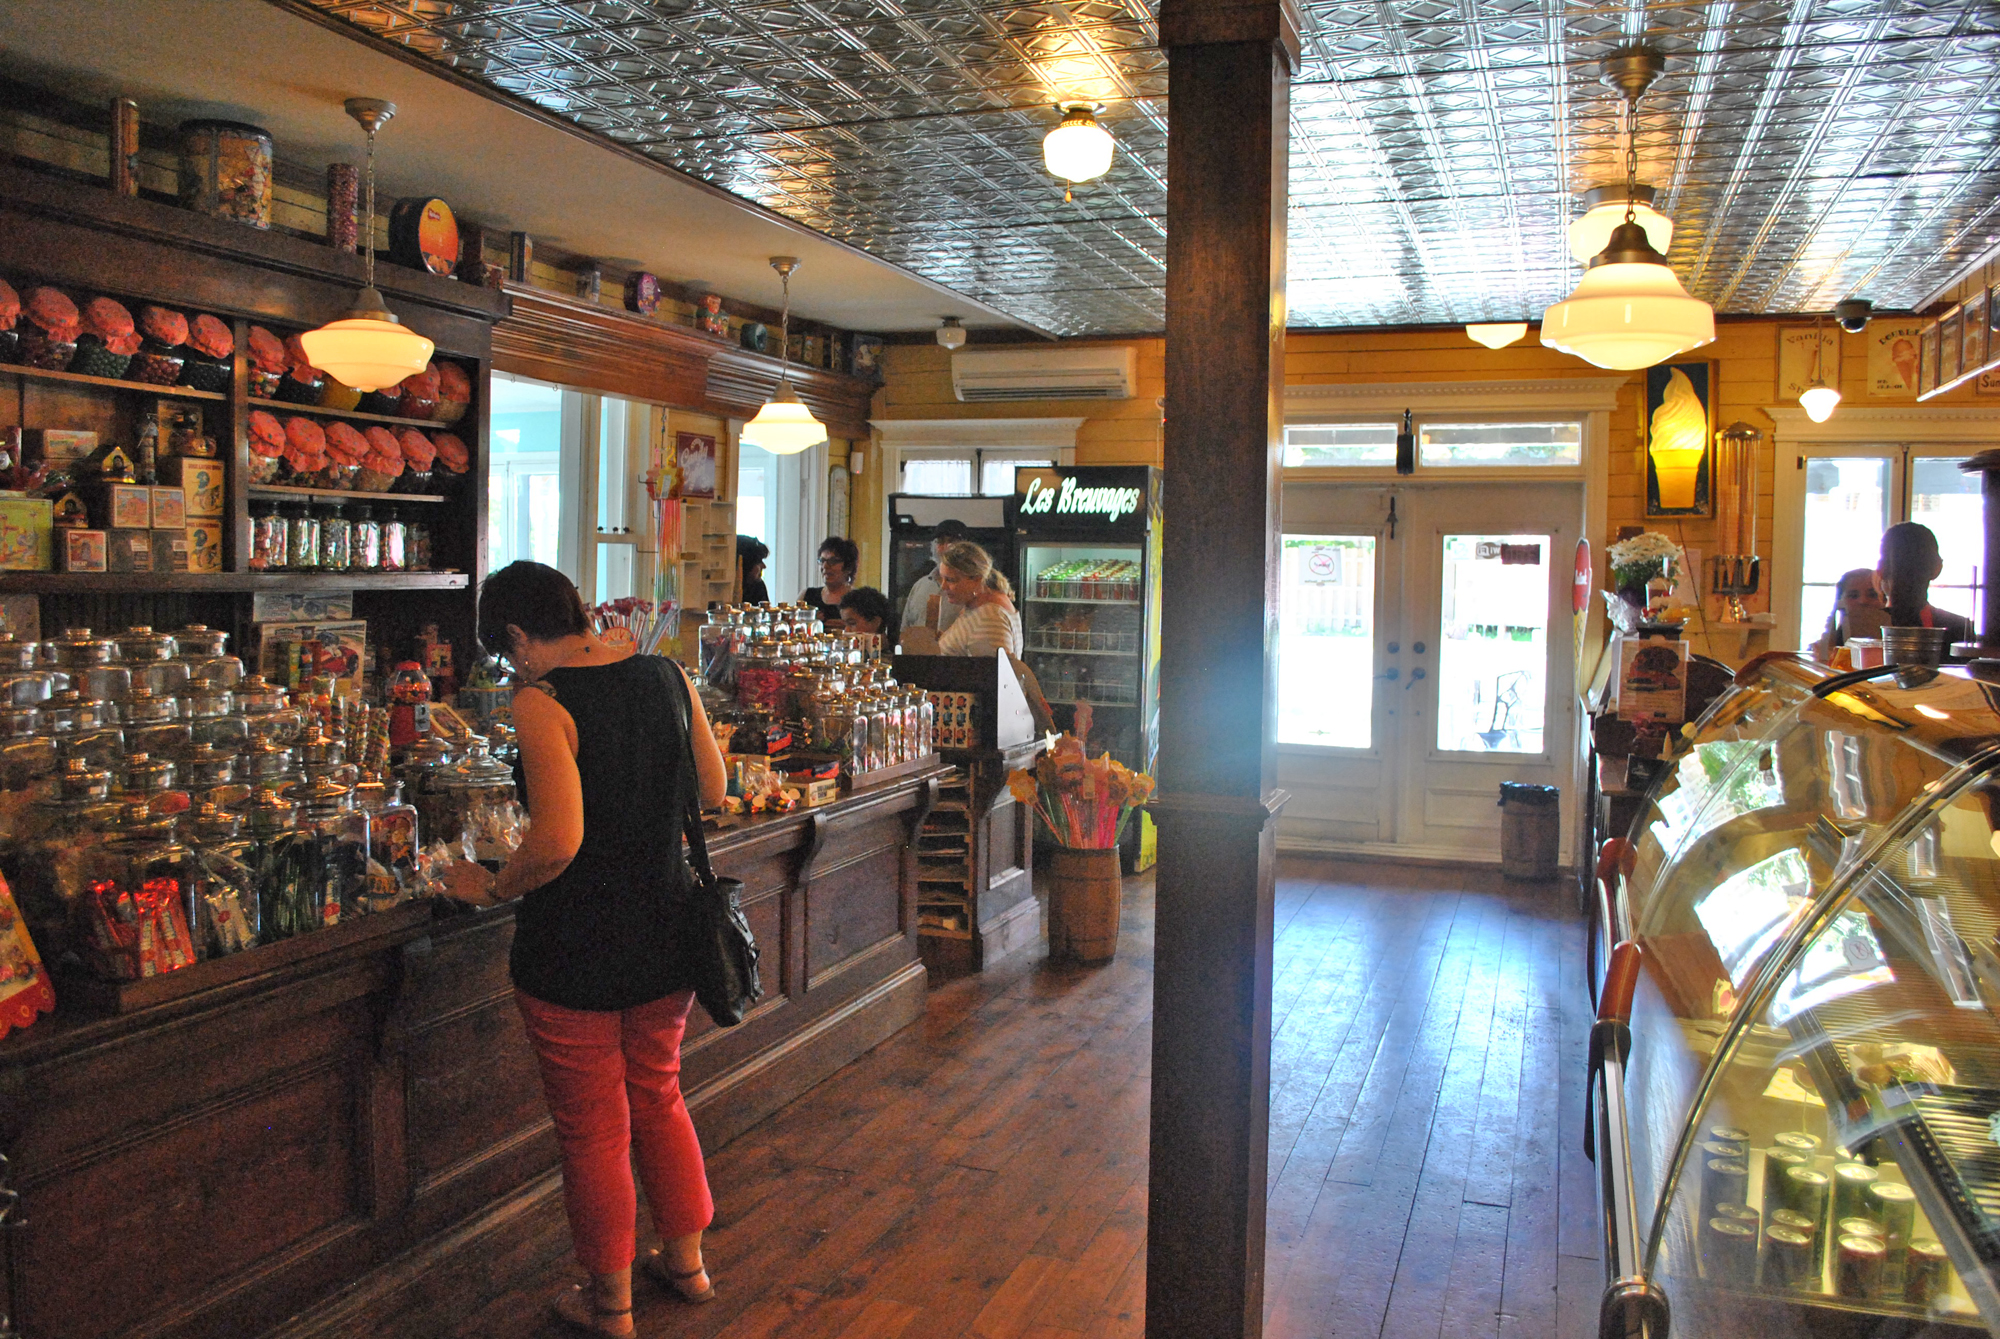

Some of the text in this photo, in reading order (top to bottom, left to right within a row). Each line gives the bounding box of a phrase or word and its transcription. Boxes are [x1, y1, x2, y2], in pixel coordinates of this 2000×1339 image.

[1786, 332, 1834, 346] Vanila
[1020, 476, 1141, 522] Les Breuvages
